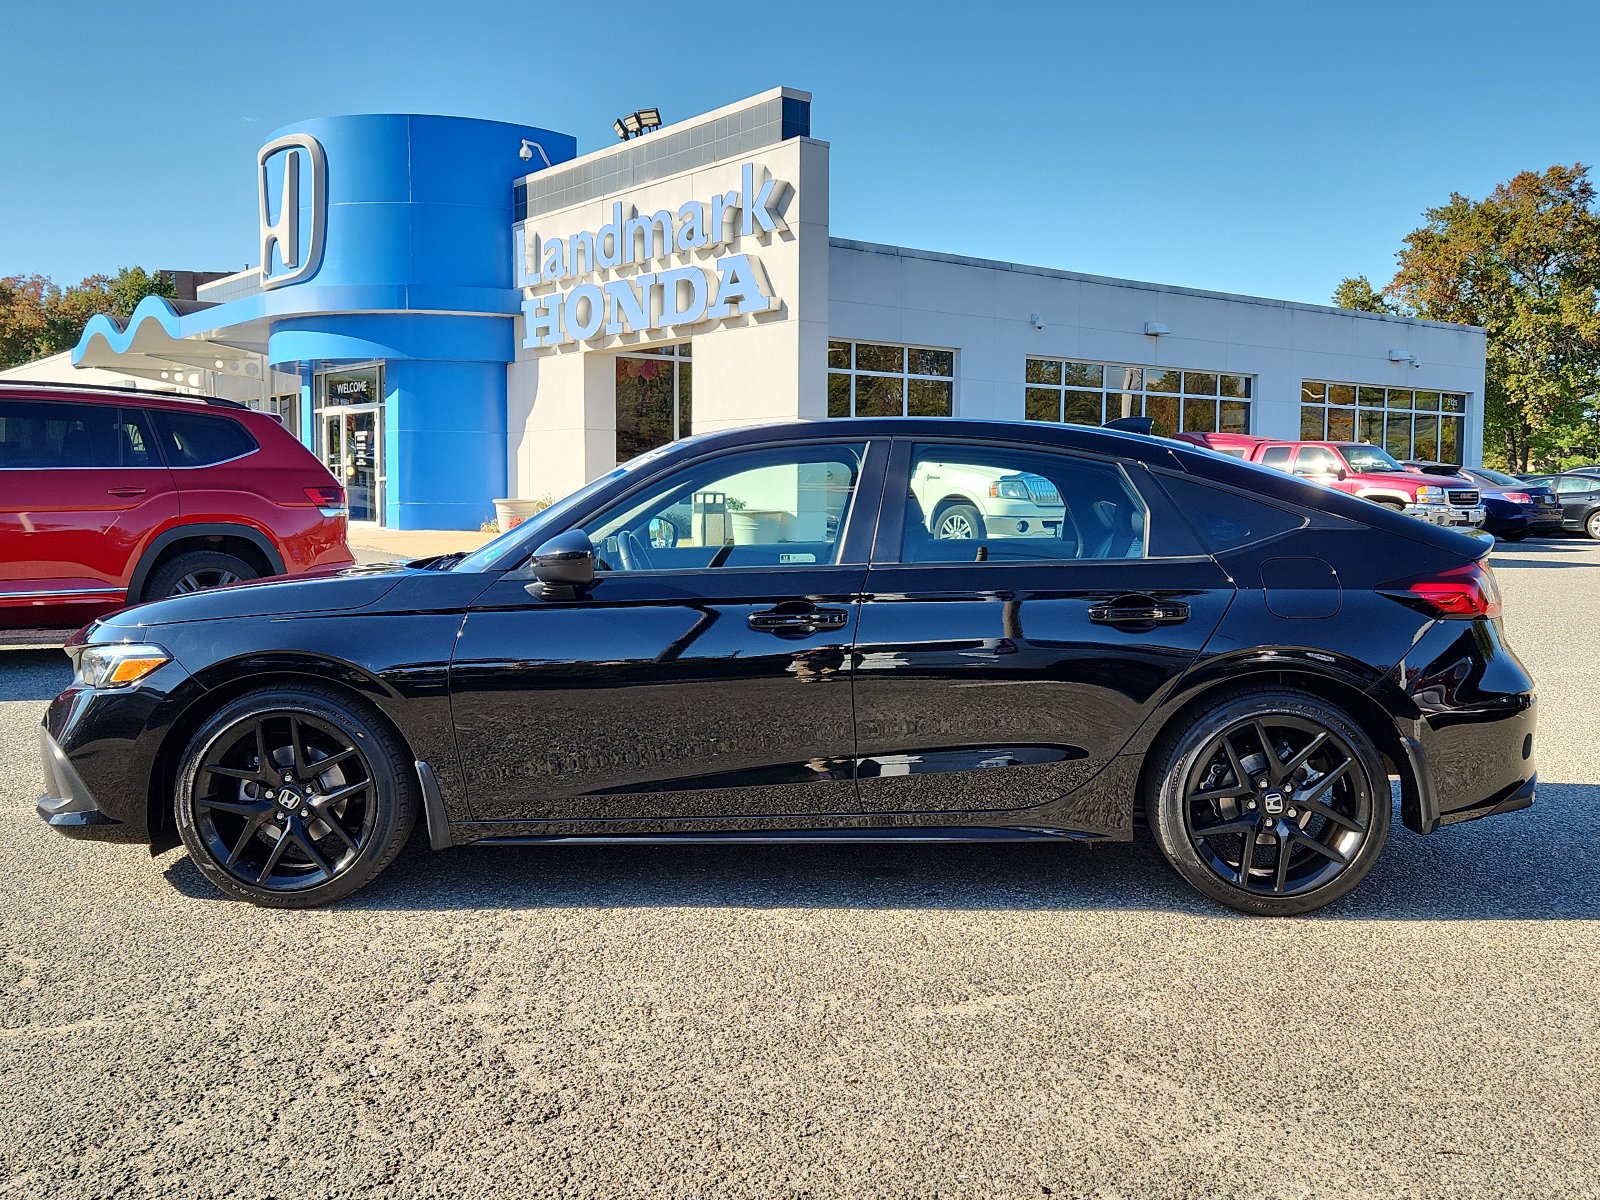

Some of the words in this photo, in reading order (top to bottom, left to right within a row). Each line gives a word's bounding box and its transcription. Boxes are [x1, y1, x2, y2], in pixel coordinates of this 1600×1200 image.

[515, 162, 777, 289] Landmark
[520, 254, 771, 350] HONDA
[336, 380, 368, 395] WELCOME
